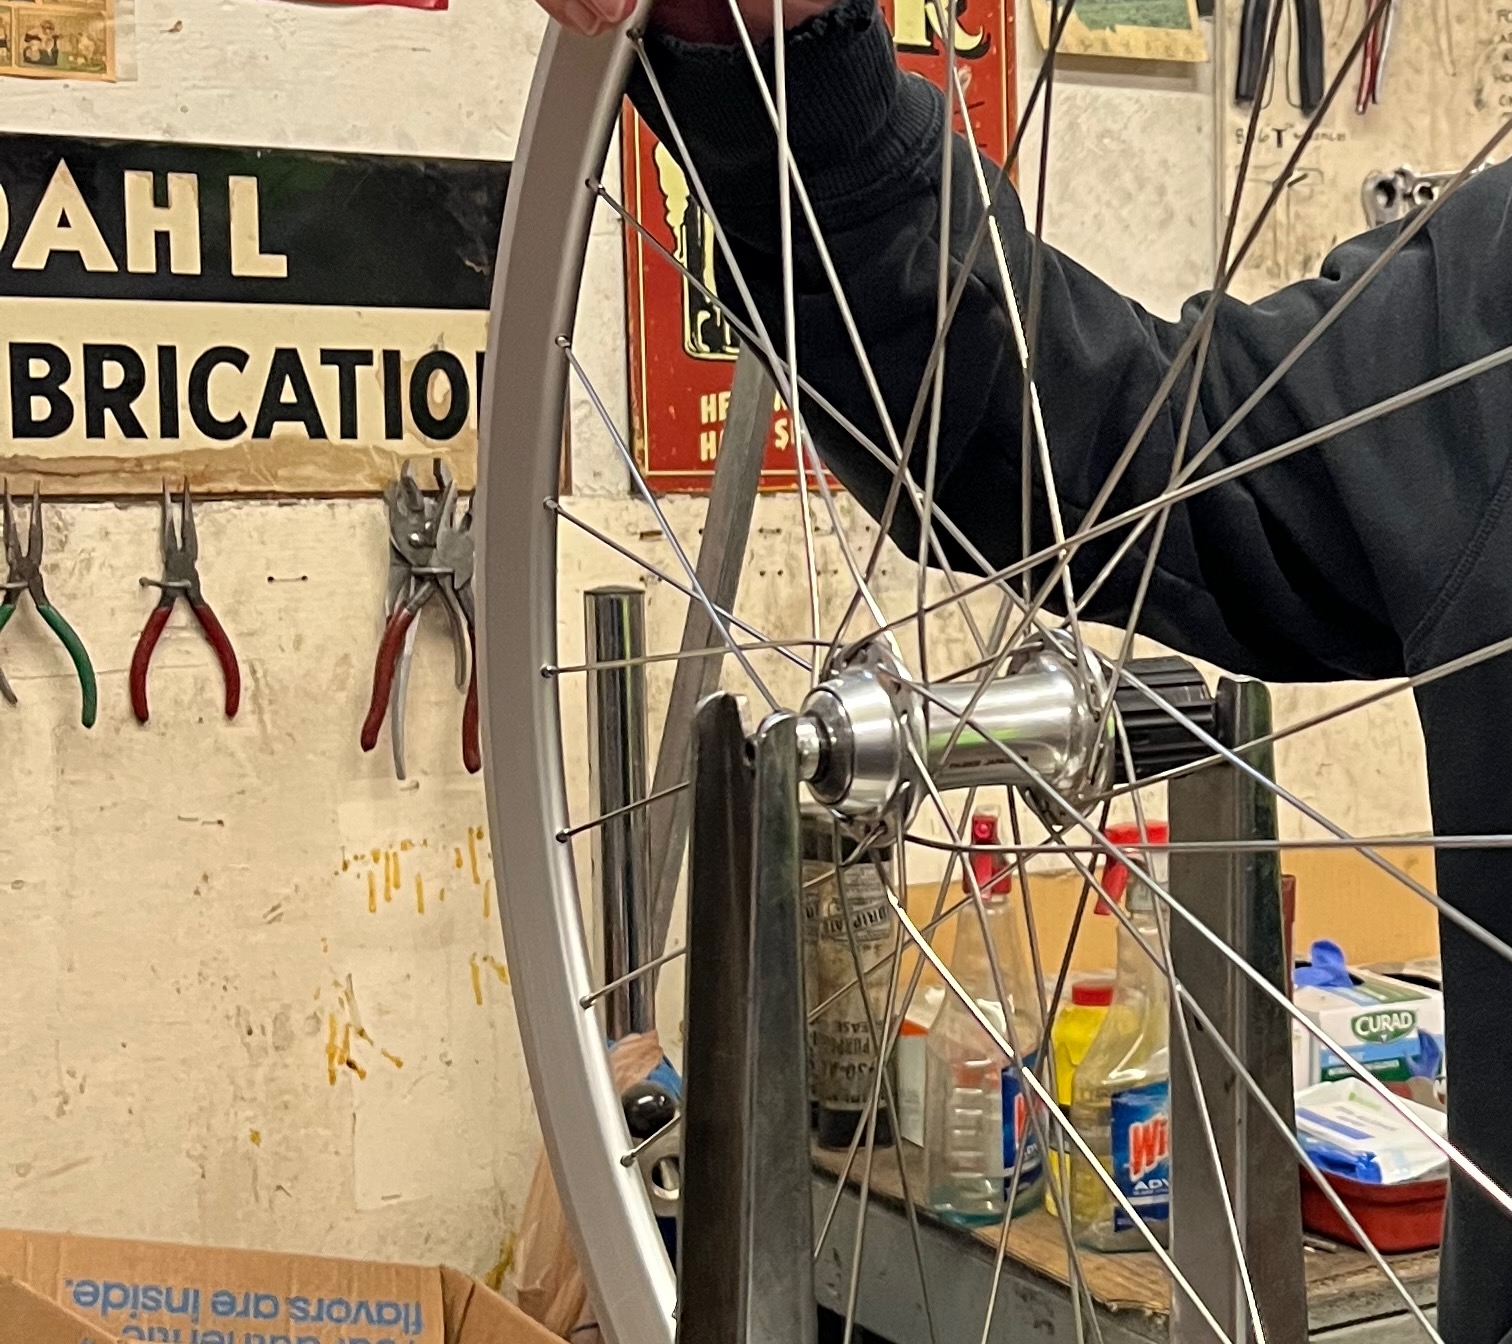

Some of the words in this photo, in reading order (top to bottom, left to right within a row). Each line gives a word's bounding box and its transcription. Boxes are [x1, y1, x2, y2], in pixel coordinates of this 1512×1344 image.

[0, 158, 289, 279] AHL
[8, 342, 489, 442] BRICATIO
[1354, 1012, 1414, 1036] CURAD
[64, 1278, 200, 1315] inside.
[212, 1288, 282, 1320] are
[289, 1295, 424, 1337] flavors
